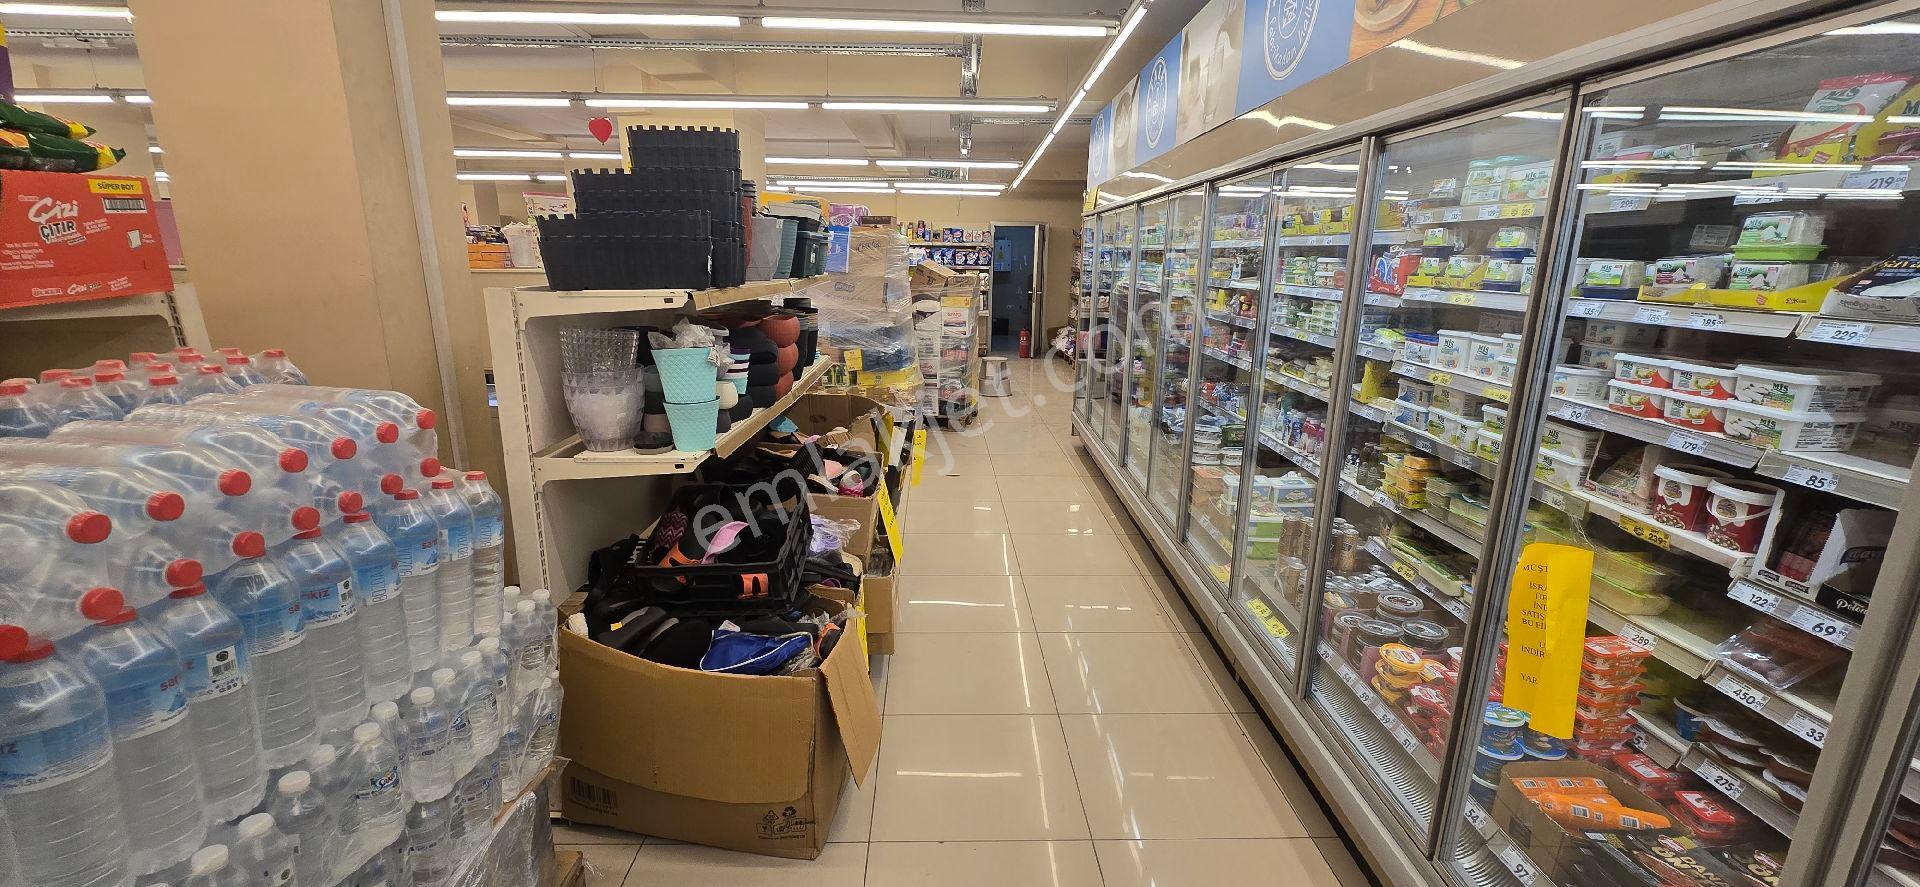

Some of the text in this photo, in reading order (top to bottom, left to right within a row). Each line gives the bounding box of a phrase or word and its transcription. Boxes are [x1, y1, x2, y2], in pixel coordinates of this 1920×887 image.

[97, 181, 135, 191] SÜPER BOY
[40, 219, 76, 242] ÇITIR
[1805, 474, 1828, 490] 85
[1750, 593, 1769, 608] 122
[1811, 622, 1837, 636] 69
[1631, 634, 1650, 648] 289
[1733, 688, 1757, 706] 450
[1805, 728, 1825, 742] 33
[1713, 775, 1735, 793] 275
[1465, 808, 1478, 824] 54
[1513, 863, 1530, 879] 97
